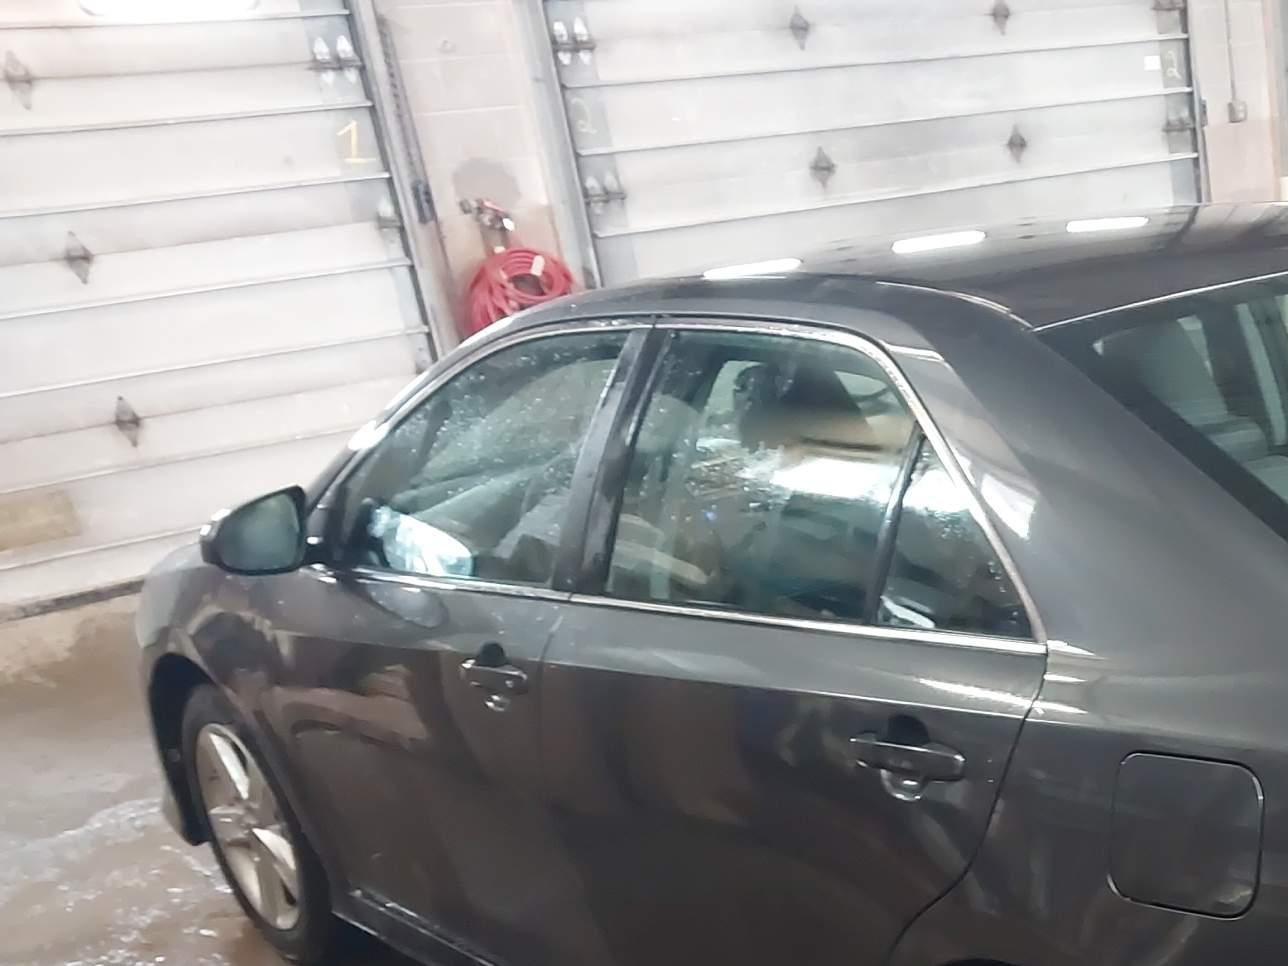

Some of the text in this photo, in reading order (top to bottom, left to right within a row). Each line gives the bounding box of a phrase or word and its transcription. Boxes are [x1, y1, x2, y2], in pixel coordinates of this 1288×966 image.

[1165, 50, 1182, 79] 2
[571, 97, 598, 135] 2
[336, 120, 377, 164] 1
